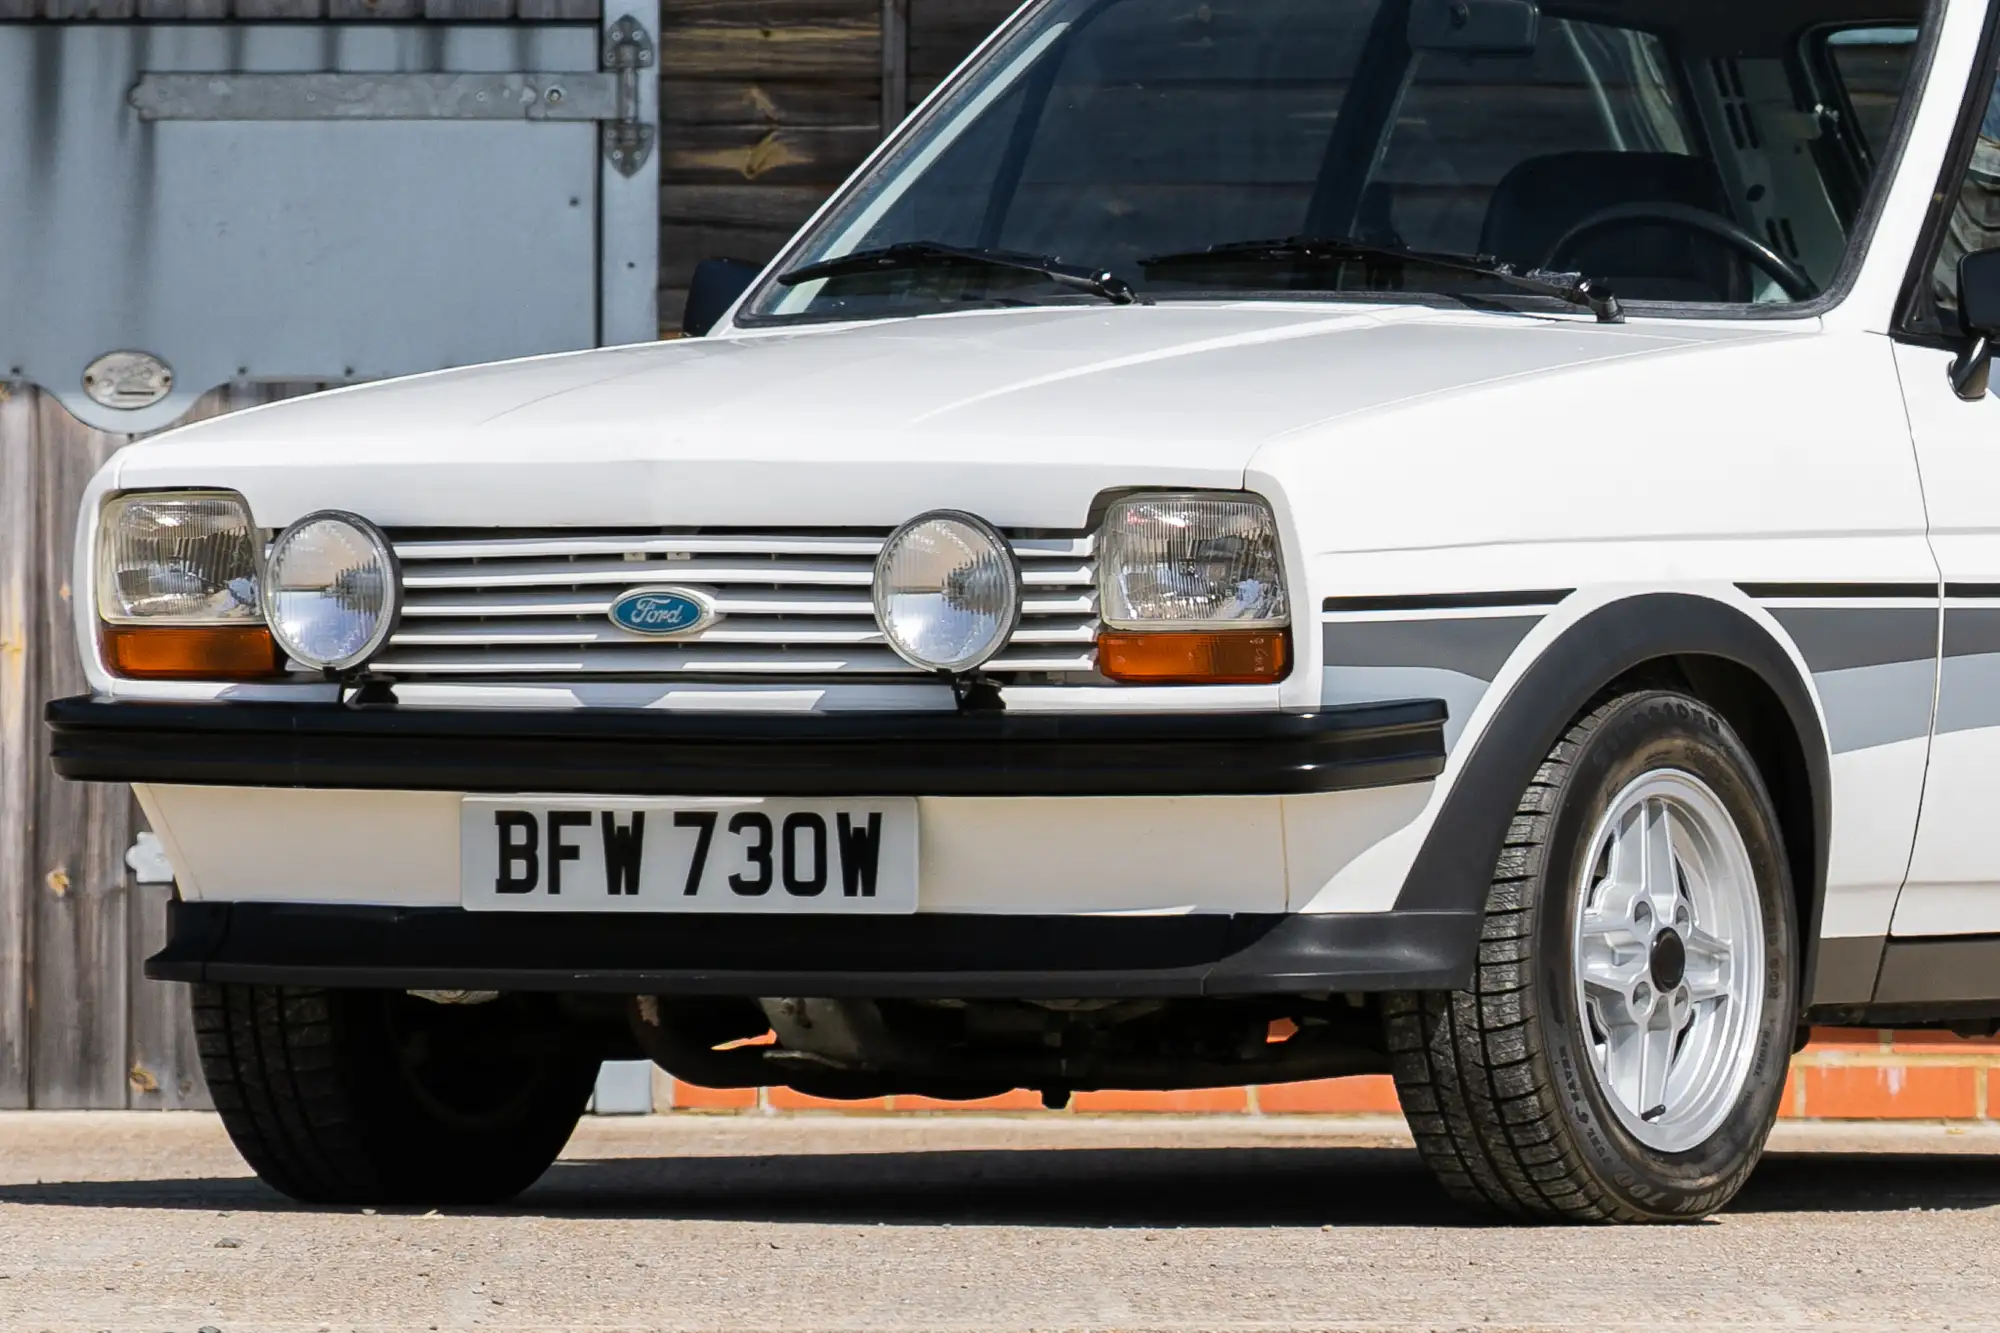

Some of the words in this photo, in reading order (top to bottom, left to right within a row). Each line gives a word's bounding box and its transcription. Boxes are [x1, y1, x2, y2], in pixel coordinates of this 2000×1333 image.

[631, 597, 684, 624] Ford
[494, 810, 645, 896] BFW
[673, 811, 883, 898] 730W
